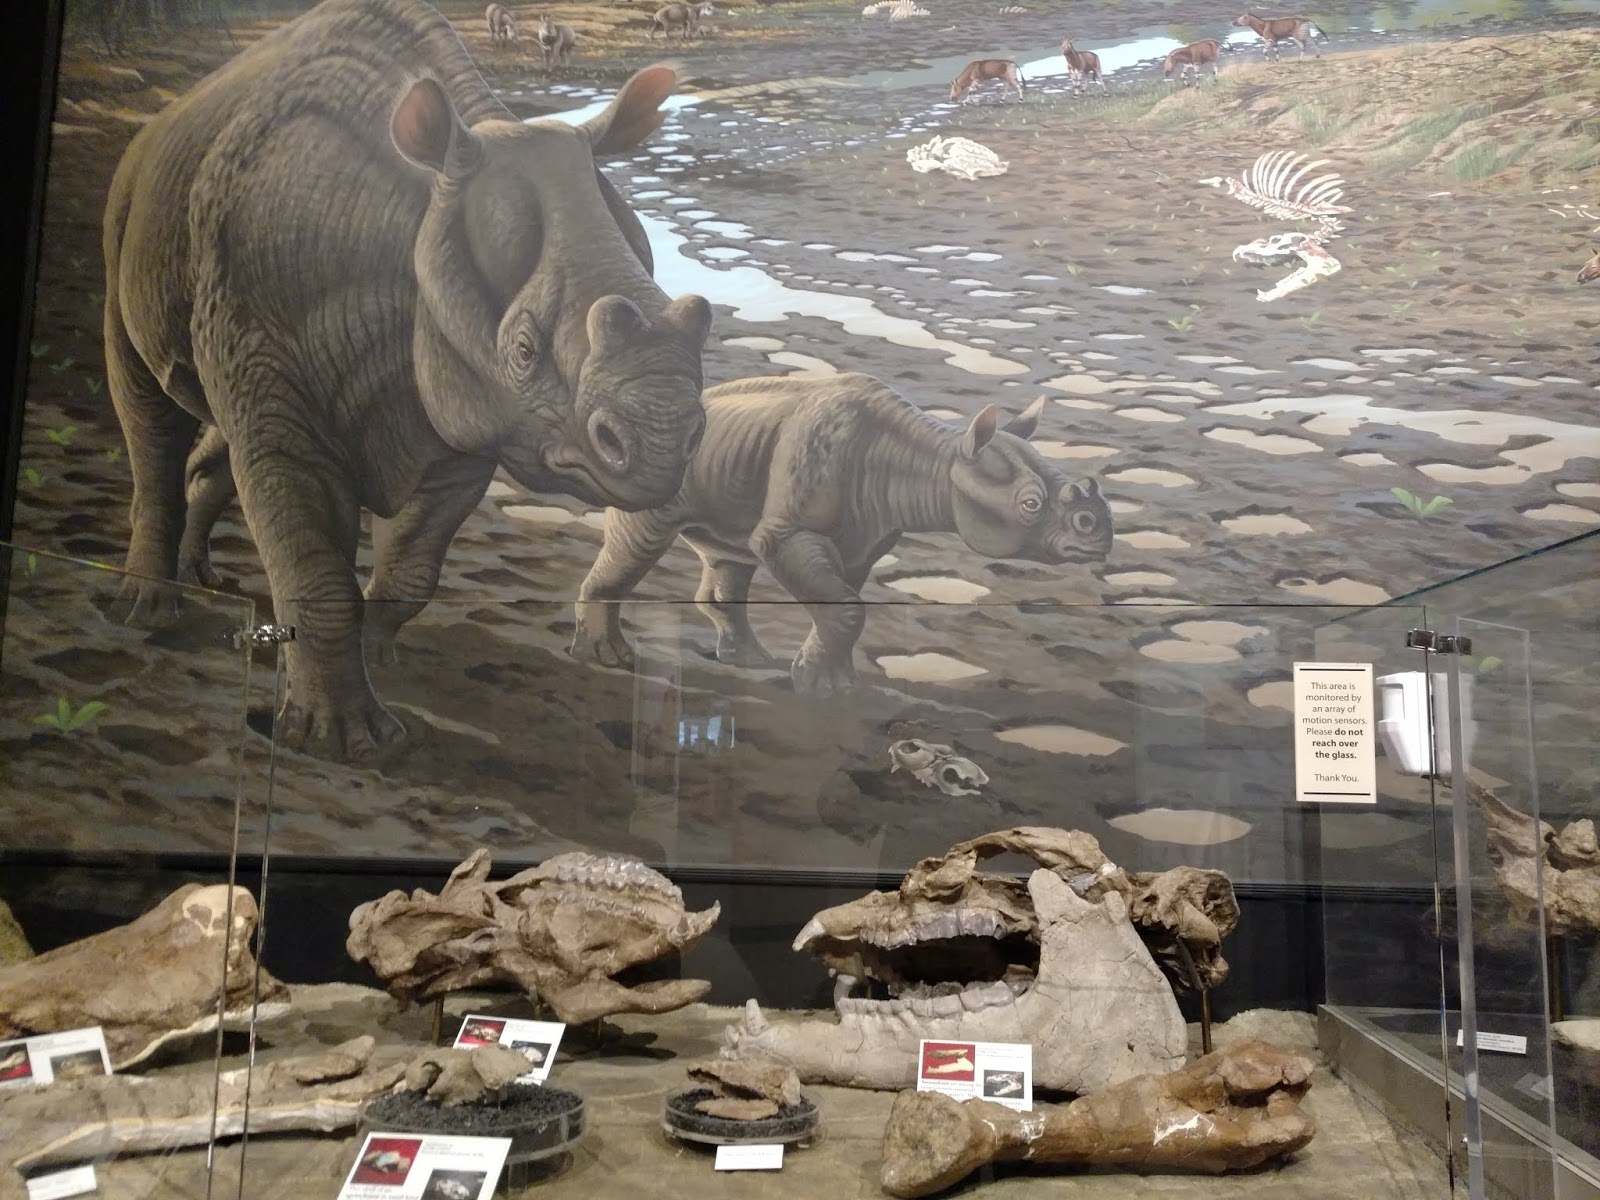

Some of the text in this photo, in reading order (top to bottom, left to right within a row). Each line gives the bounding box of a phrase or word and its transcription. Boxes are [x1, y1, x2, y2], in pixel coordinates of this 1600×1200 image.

[1311, 682, 1327, 690] This
[1349, 682, 1355, 690] is
[1305, 693, 1361, 703] monitored by
[1324, 706, 1345, 714] array
[1347, 705, 1356, 713] of
[1312, 739, 1336, 747] reach
[1332, 751, 1357, 760] glass.
[1314, 773, 1359, 782] Thank You.
